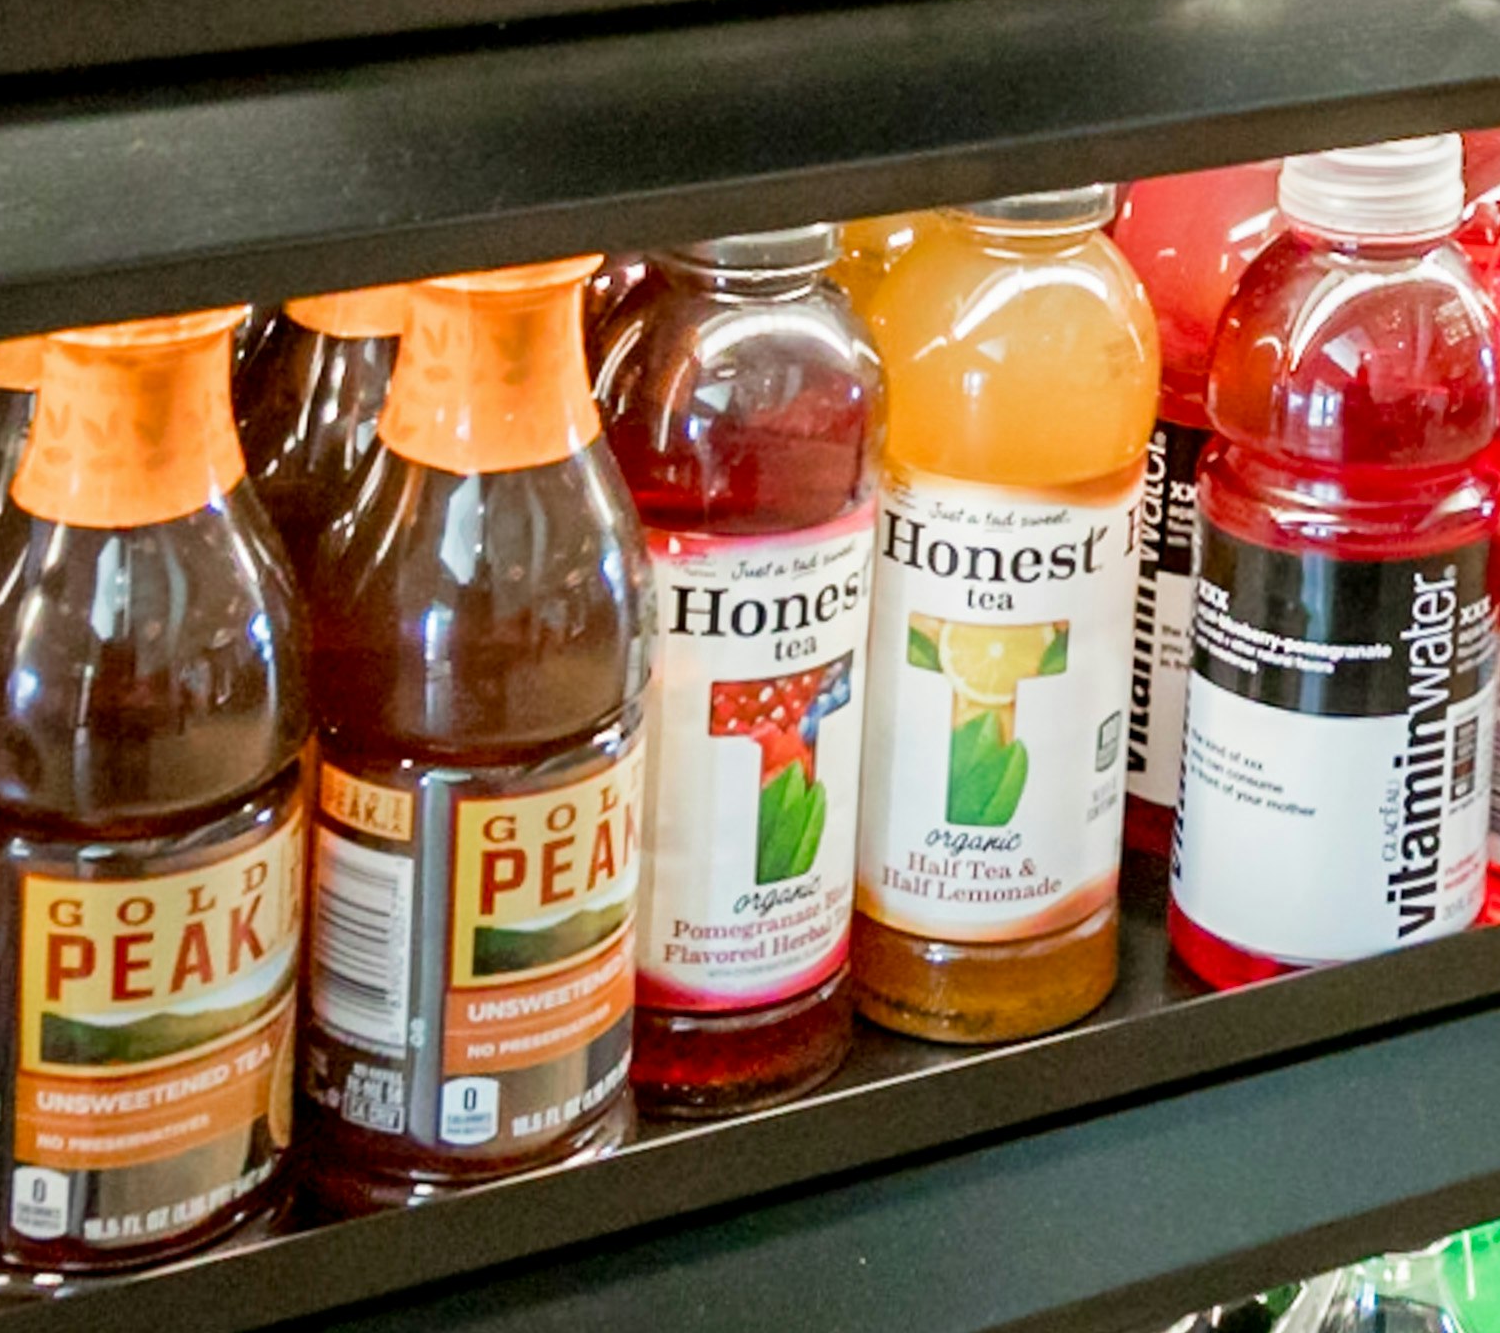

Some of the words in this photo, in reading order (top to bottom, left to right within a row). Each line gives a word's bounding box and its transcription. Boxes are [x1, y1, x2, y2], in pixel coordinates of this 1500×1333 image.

[928, 501, 963, 524] Just
[967, 513, 981, 525] a
[985, 510, 1014, 532] tad
[882, 508, 1109, 584] Honest
[731, 559, 771, 581] Just
[774, 563, 787, 575] a
[966, 587, 1015, 612] tea
[774, 635, 818, 662] tea
[1387, 570, 1459, 939] vitaminwater
[1266, 794, 1318, 819] mother
[924, 828, 1023, 857] organic
[907, 850, 962, 879] Half
[966, 859, 1012, 881] Tea
[1018, 857, 1037, 877] &
[48, 861, 268, 928] GOLD
[881, 865, 934, 898] Half
[936, 876, 1063, 903] Lemonade
[44, 894, 265, 1003] PEAK
[664, 941, 766, 966] Flavored
[36, 1062, 231, 1114] UNSWEETENED
[235, 1043, 273, 1075] TEA
[463, 1086, 477, 1112] 0
